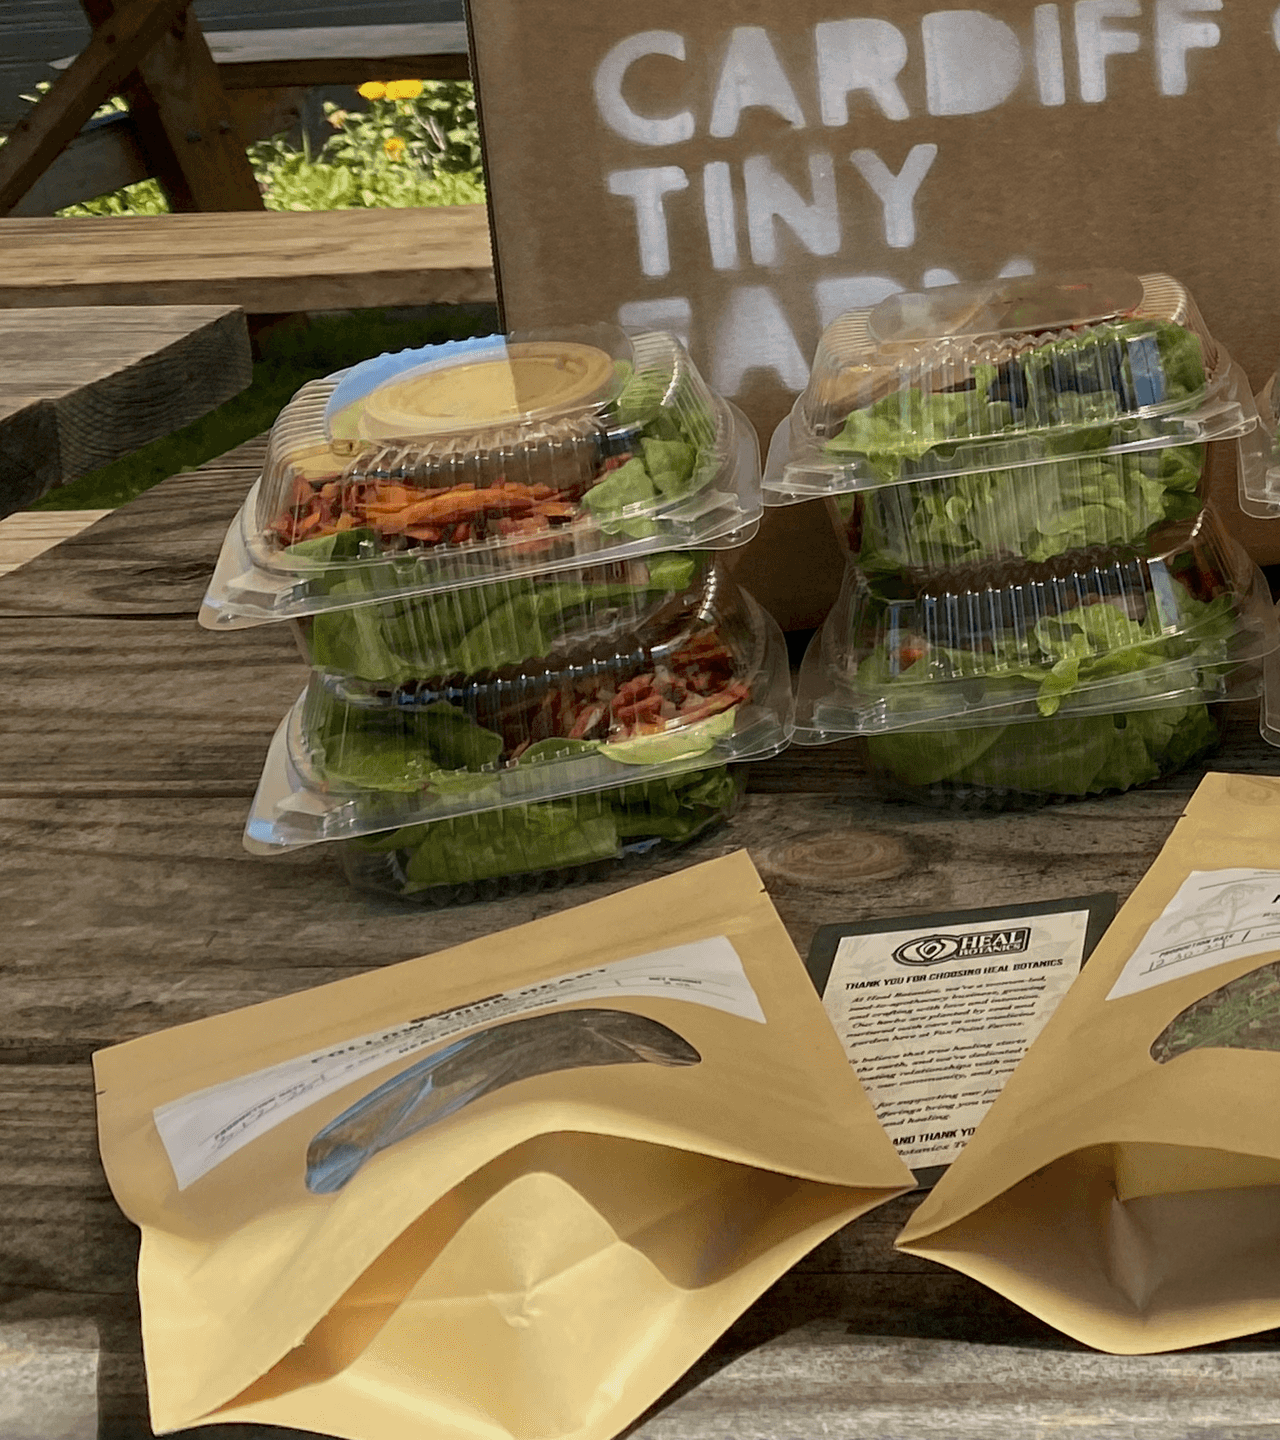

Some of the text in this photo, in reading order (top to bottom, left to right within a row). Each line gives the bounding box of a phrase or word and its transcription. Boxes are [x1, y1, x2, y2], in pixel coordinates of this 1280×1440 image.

[607, 142, 938, 276] TINY
[961, 931, 1023, 950] HEAL
[845, 958, 1064, 991] THANK YOU FOR CHOOSING HEAL BOTANICS
[892, 1127, 977, 1146] AND THANK YO
